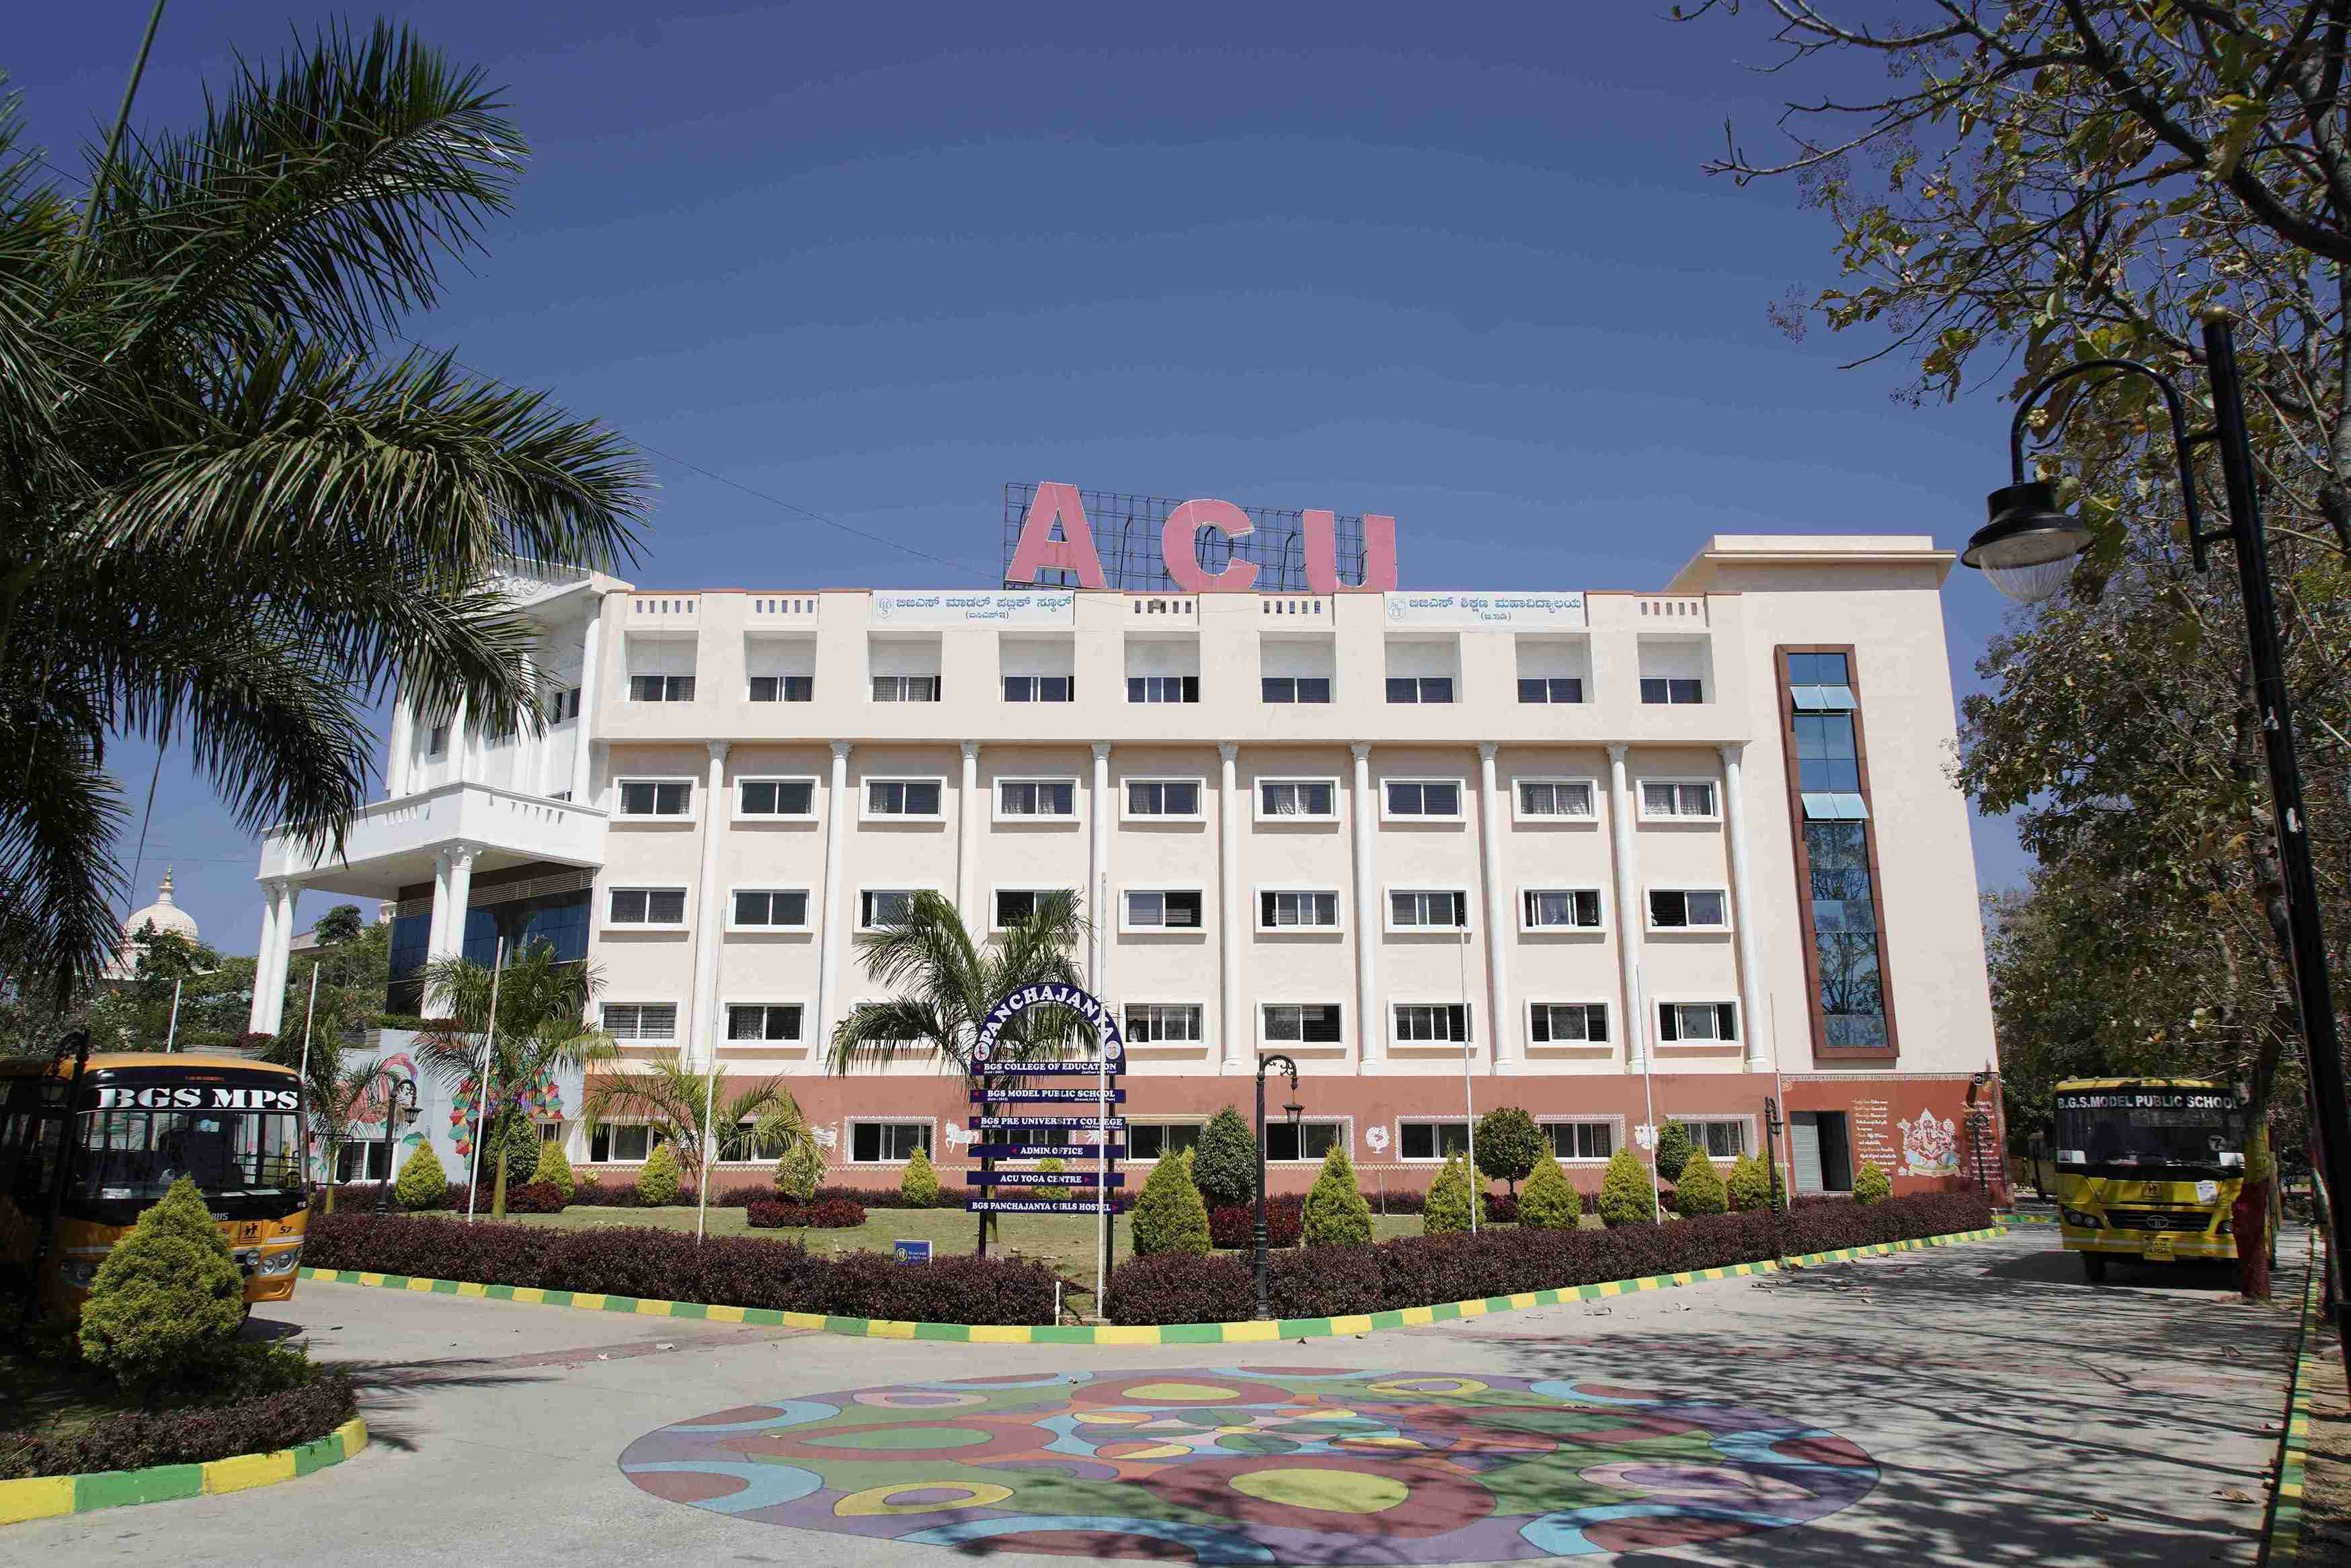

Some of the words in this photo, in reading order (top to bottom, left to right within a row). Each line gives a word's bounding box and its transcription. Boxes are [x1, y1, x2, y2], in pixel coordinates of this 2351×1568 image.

[1004, 481, 1398, 592] ACU
[980, 985, 1114, 1046] PANCHAJANYA
[97, 1087, 202, 1108] BGS
[211, 1088, 298, 1109] MPS
[2135, 1096, 2183, 1108] PUBLIC
[1021, 1175, 1045, 1183] YOGA
[990, 1202, 1050, 1210] PANCHAJANYA
